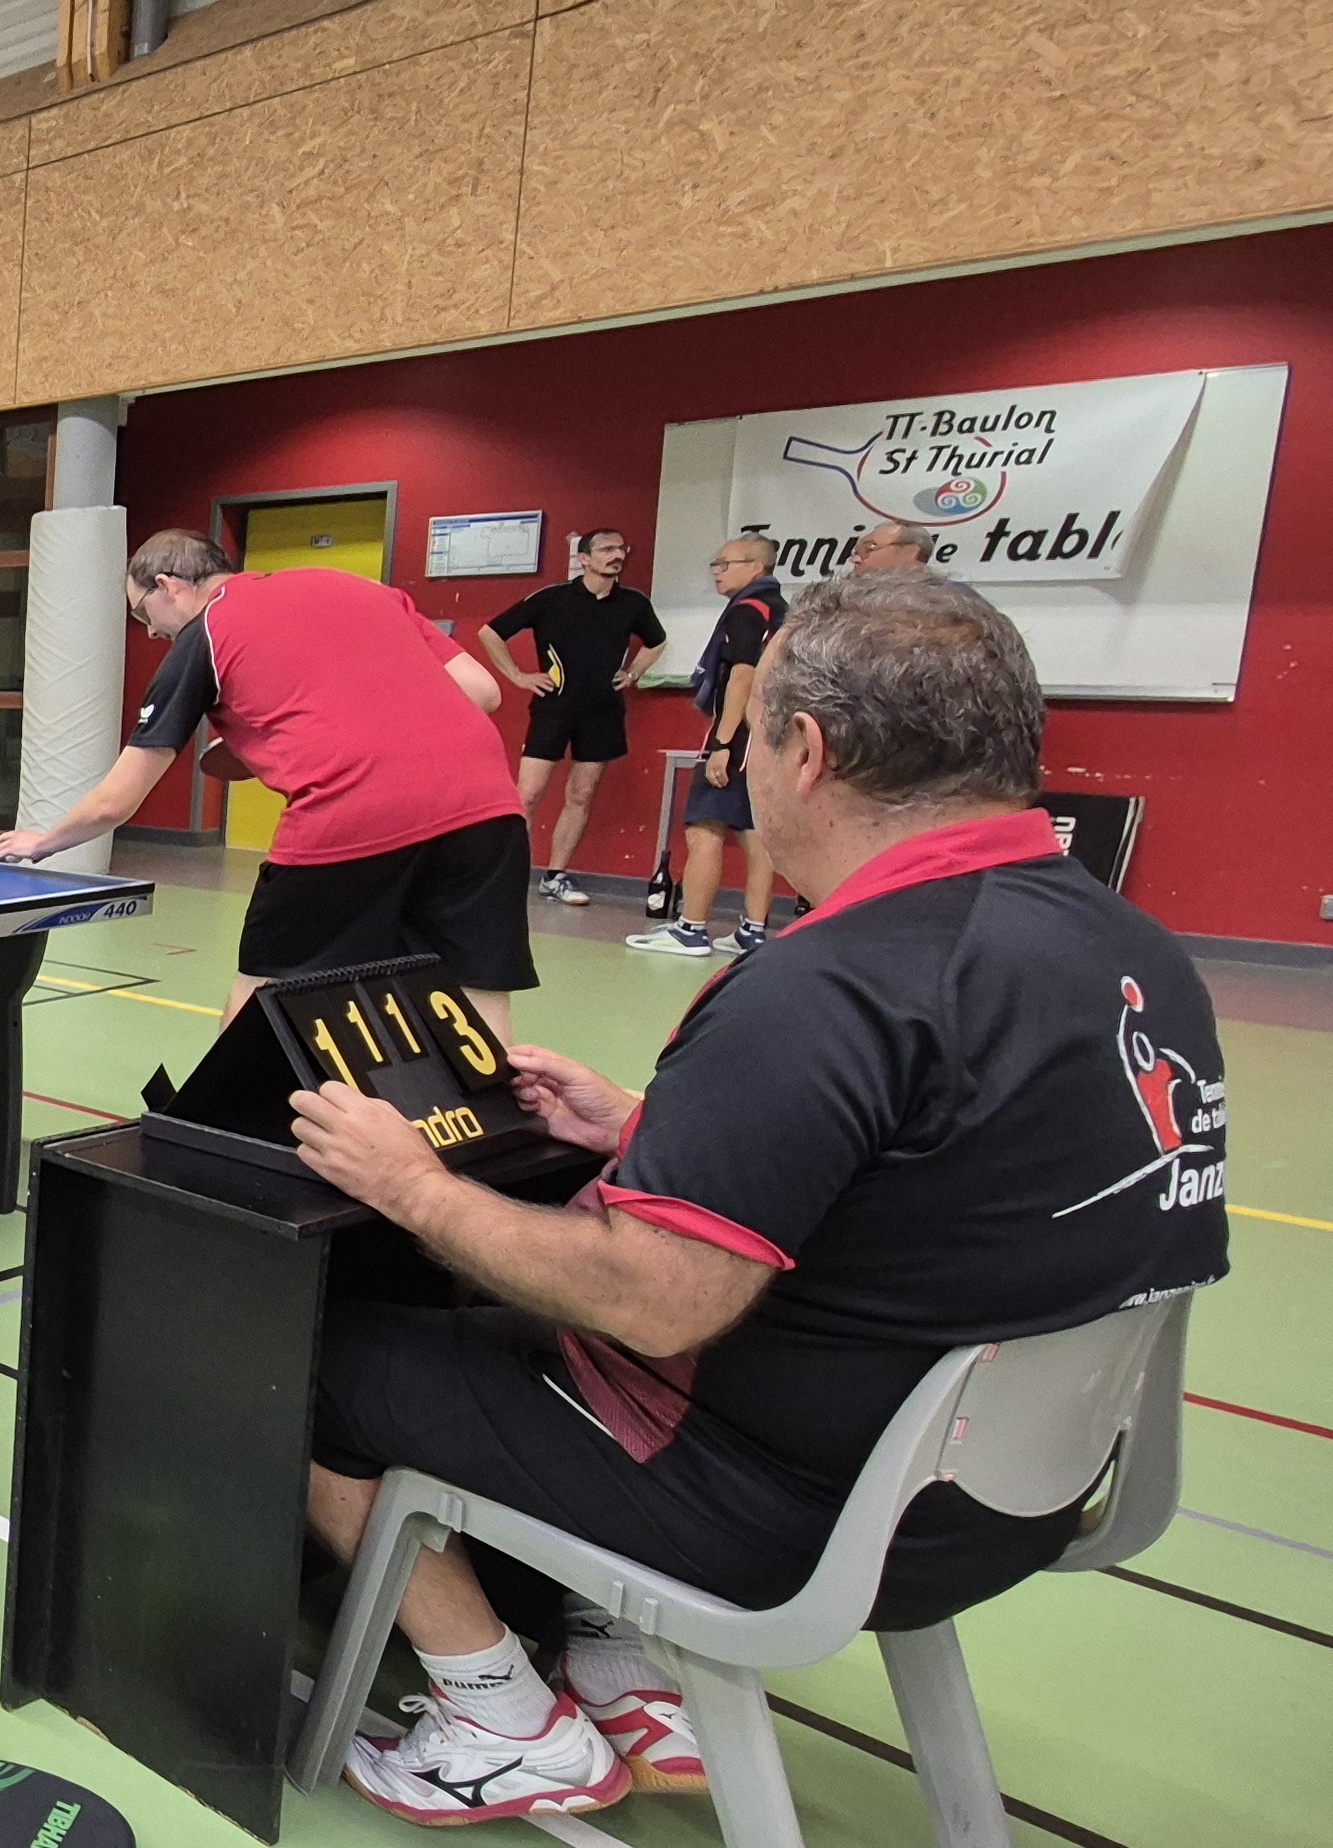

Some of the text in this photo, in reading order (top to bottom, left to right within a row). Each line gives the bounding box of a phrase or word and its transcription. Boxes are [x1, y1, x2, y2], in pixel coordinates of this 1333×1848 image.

[885, 404, 1057, 441] TT-Baulon
[879, 438, 1055, 477] St Thurial
[979, 510, 1125, 562] tabl
[103, 901, 138, 919] 440
[315, 990, 497, 1091] 1 1 1 3
[410, 1106, 485, 1148] ndro
[1191, 1108, 1211, 1133] de
[1159, 1158, 1225, 1211] Janz
[29, 1800, 82, 1848] TIBHA
